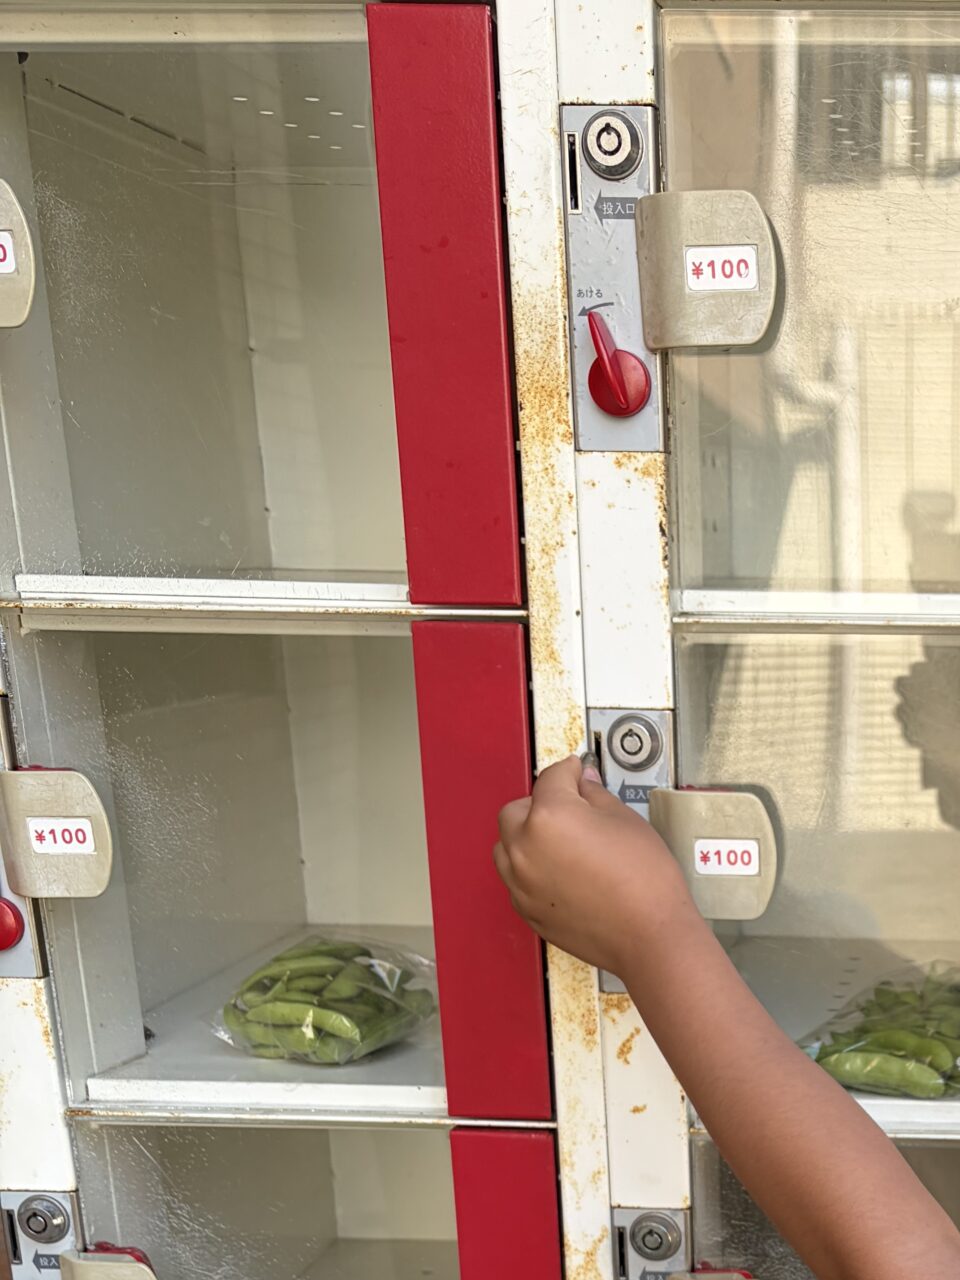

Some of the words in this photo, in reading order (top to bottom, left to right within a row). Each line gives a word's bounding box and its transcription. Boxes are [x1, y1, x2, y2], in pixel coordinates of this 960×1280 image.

[603, 202, 636, 215] 投入口
[691, 258, 749, 280] ¥100
[576, 288, 603, 299] あける
[34, 828, 87, 845] ¥100
[699, 850, 752, 866] ¥100
